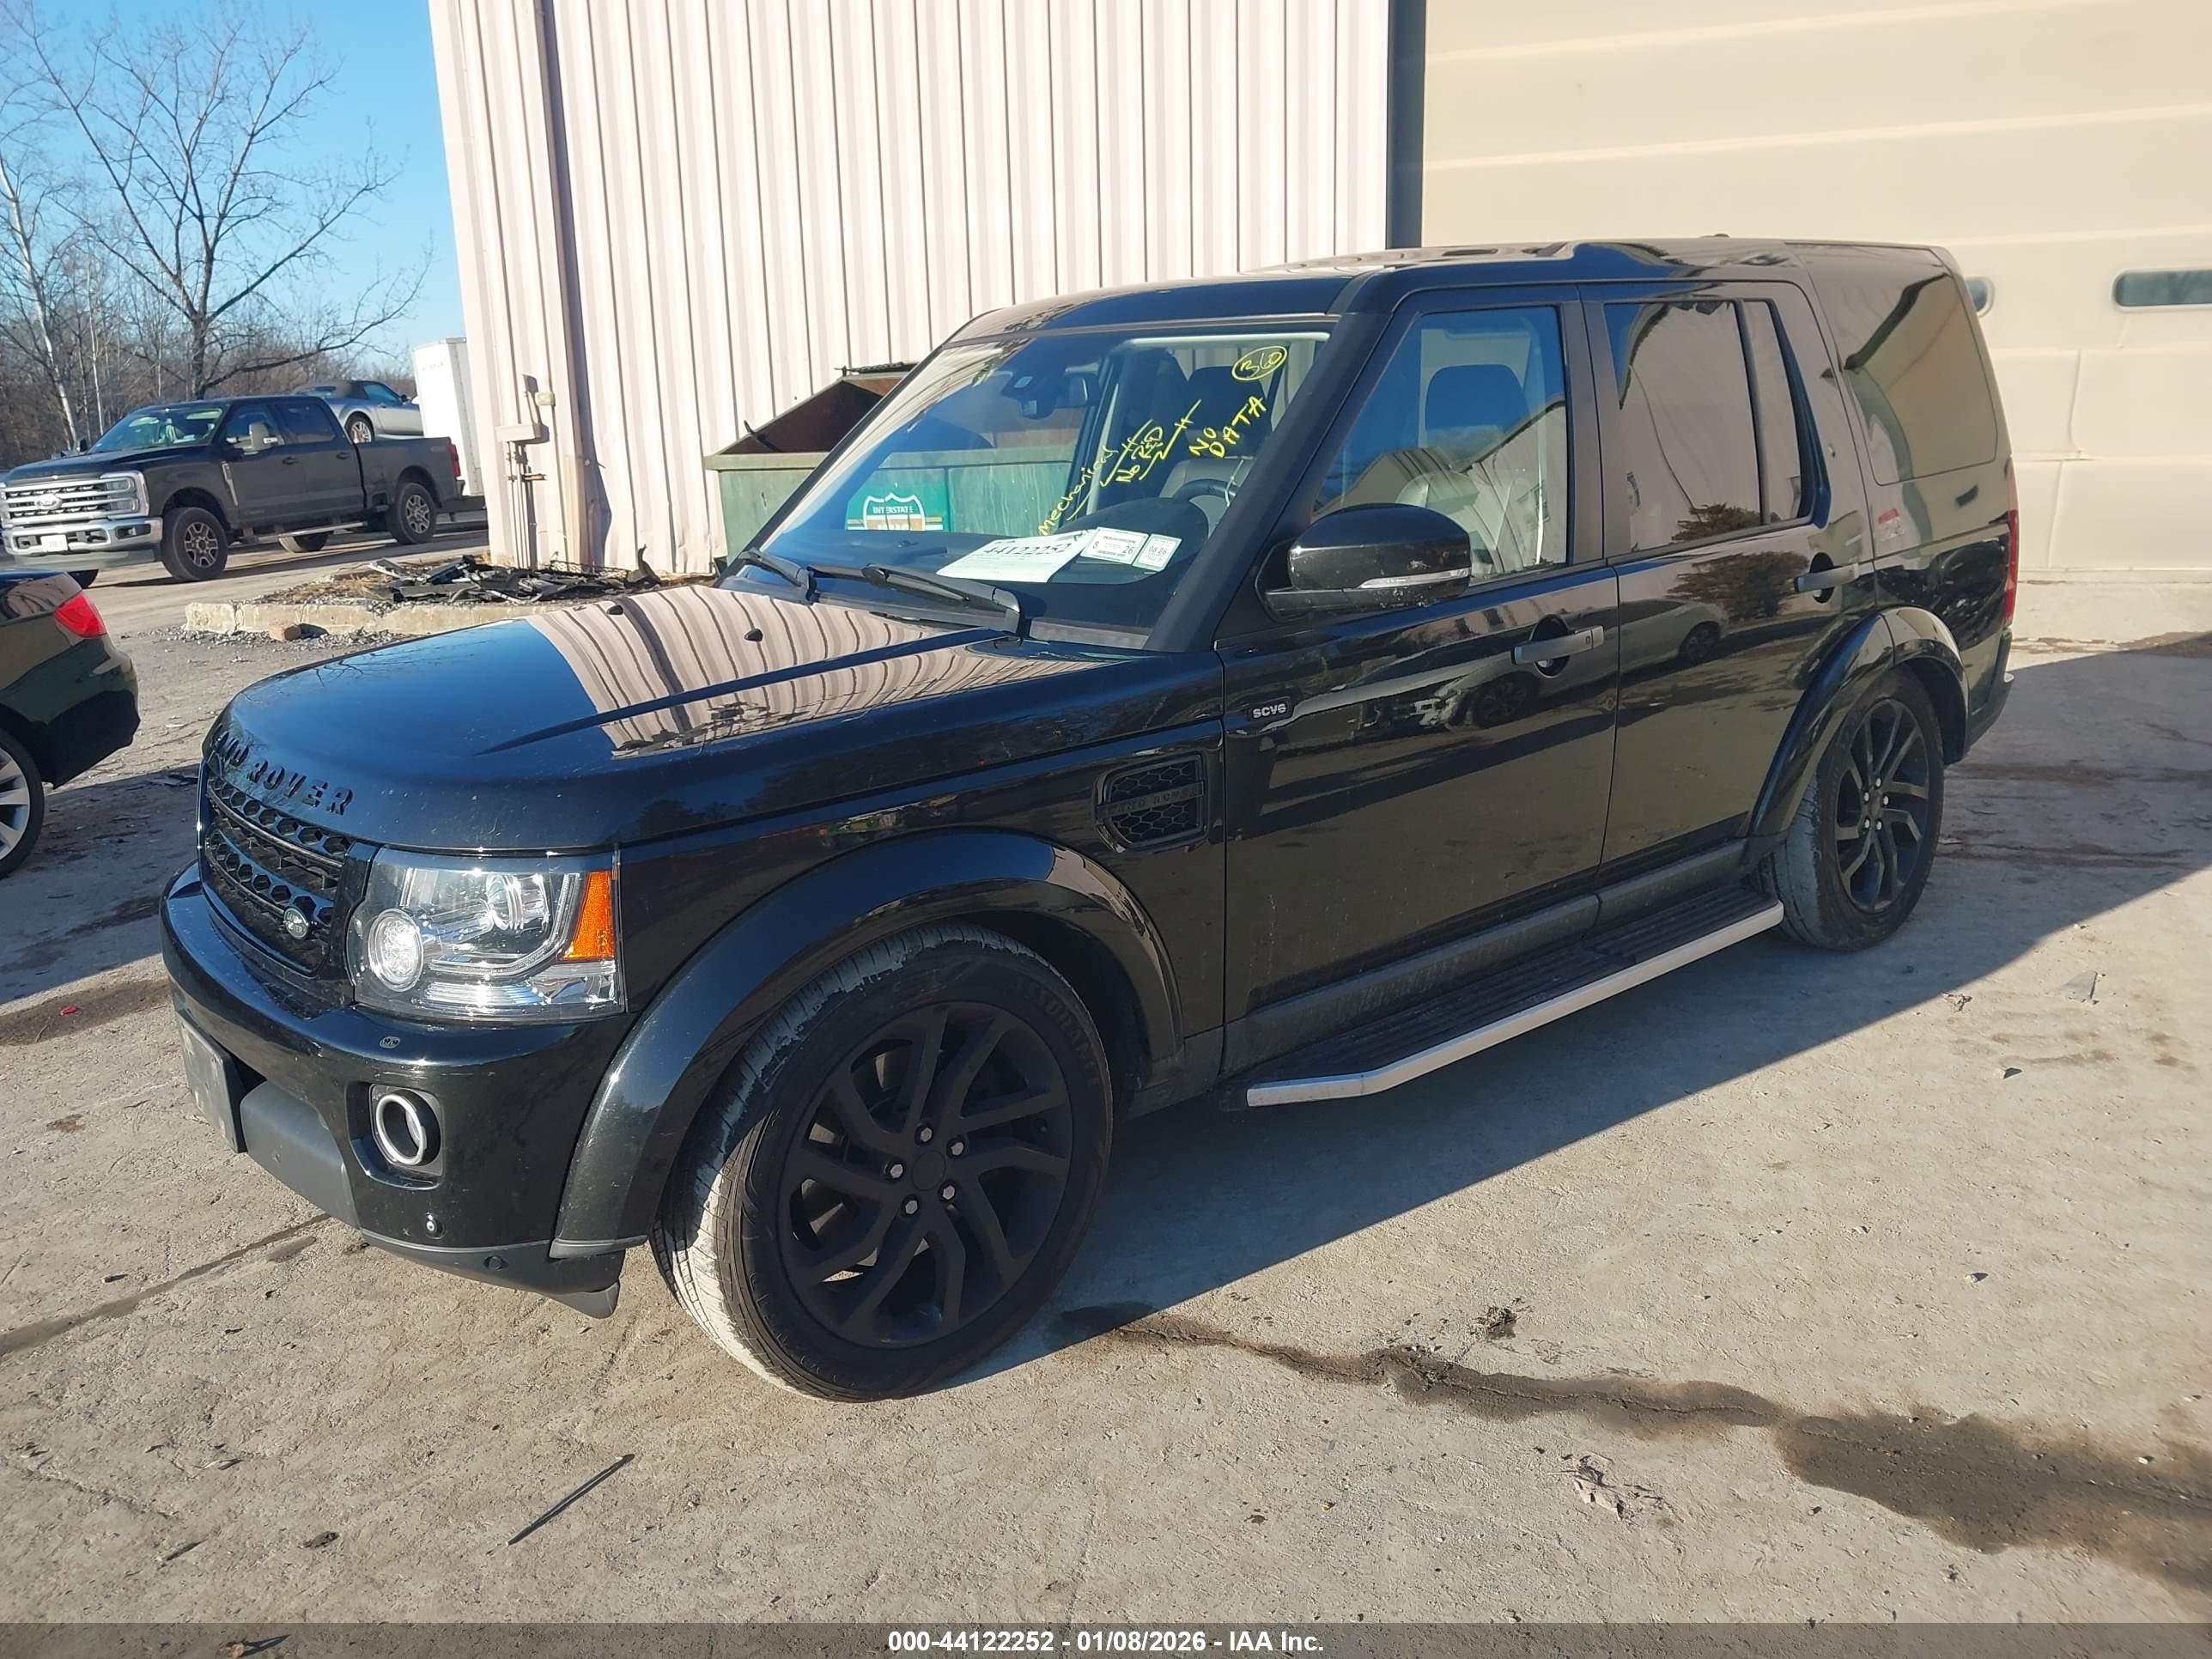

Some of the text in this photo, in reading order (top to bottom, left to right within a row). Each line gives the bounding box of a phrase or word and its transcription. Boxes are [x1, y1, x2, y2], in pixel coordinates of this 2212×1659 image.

[1188, 427, 1217, 456] NO
[1209, 396, 1267, 458] DATA
[1252, 703, 1286, 718] SCV6
[246, 759, 354, 817] ROVER
